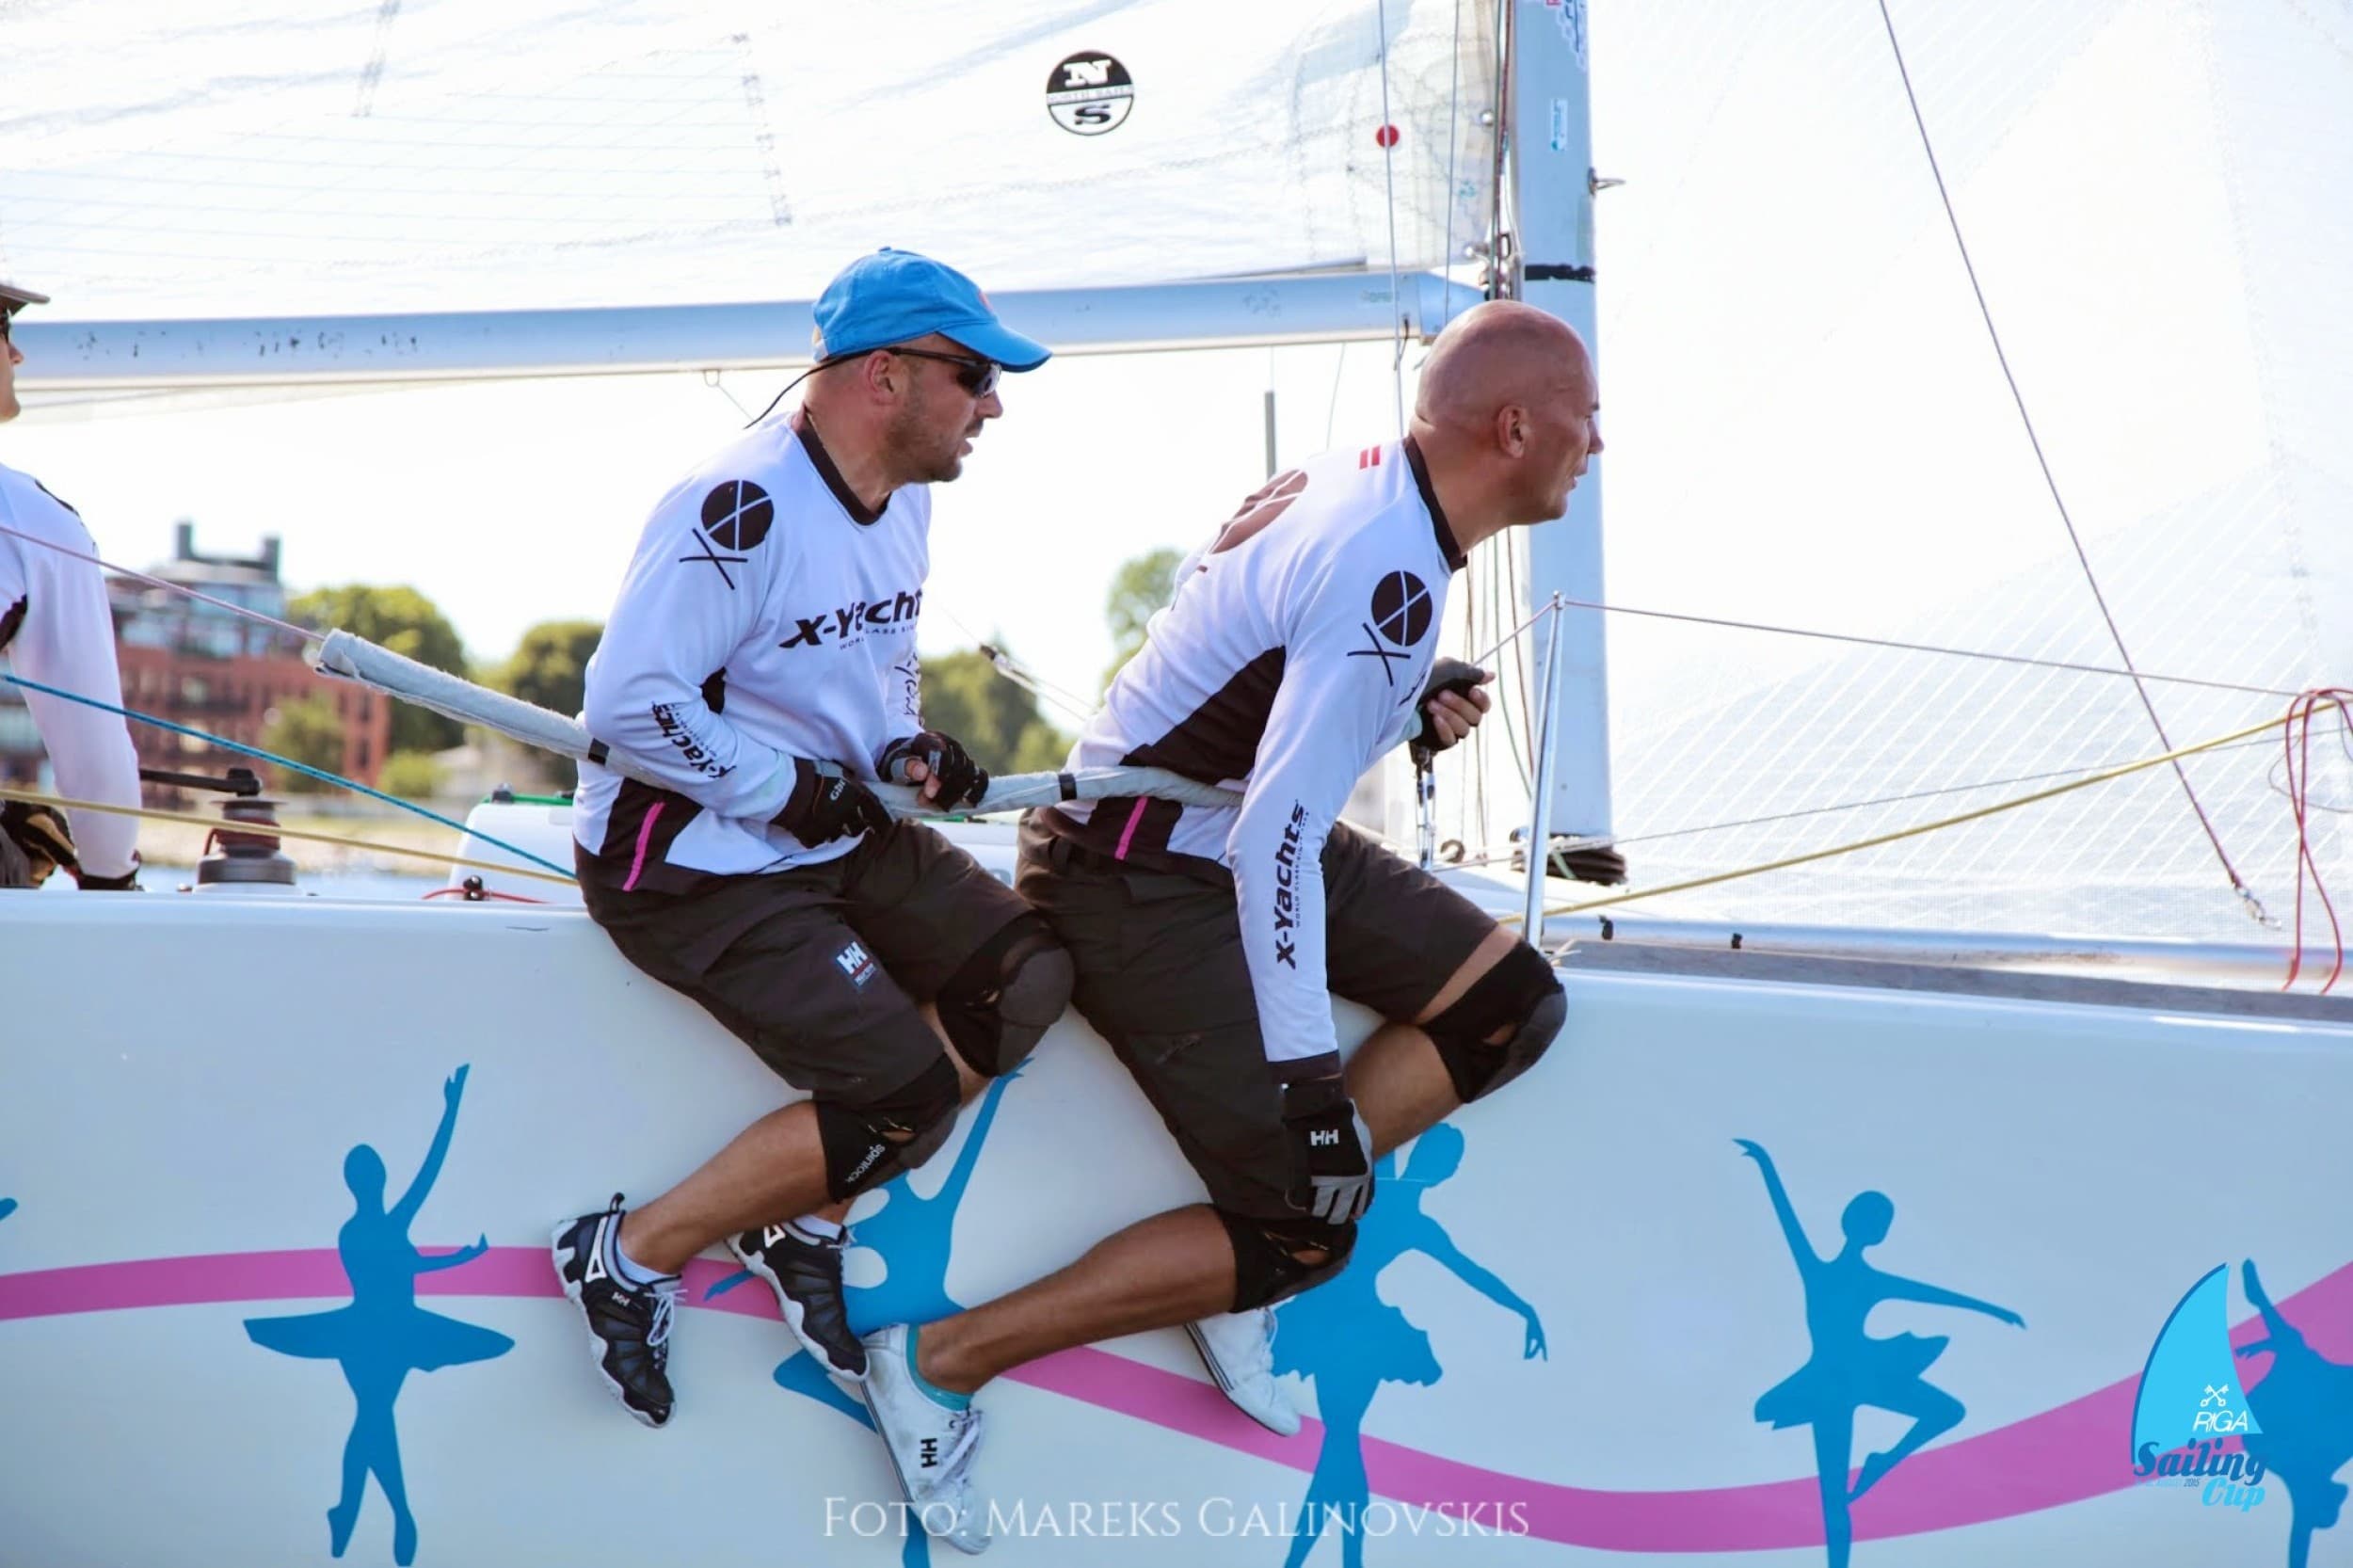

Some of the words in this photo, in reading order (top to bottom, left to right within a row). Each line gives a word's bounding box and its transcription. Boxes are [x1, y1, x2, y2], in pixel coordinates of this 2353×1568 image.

[1063, 58, 1112, 88] N
[1074, 104, 1112, 125] S
[840, 636, 864, 650] WORL
[865, 625, 897, 634] LASS
[1274, 802, 1305, 970] X-Yachts
[1310, 1129, 1339, 1146] HH
[920, 1437, 937, 1468] HH
